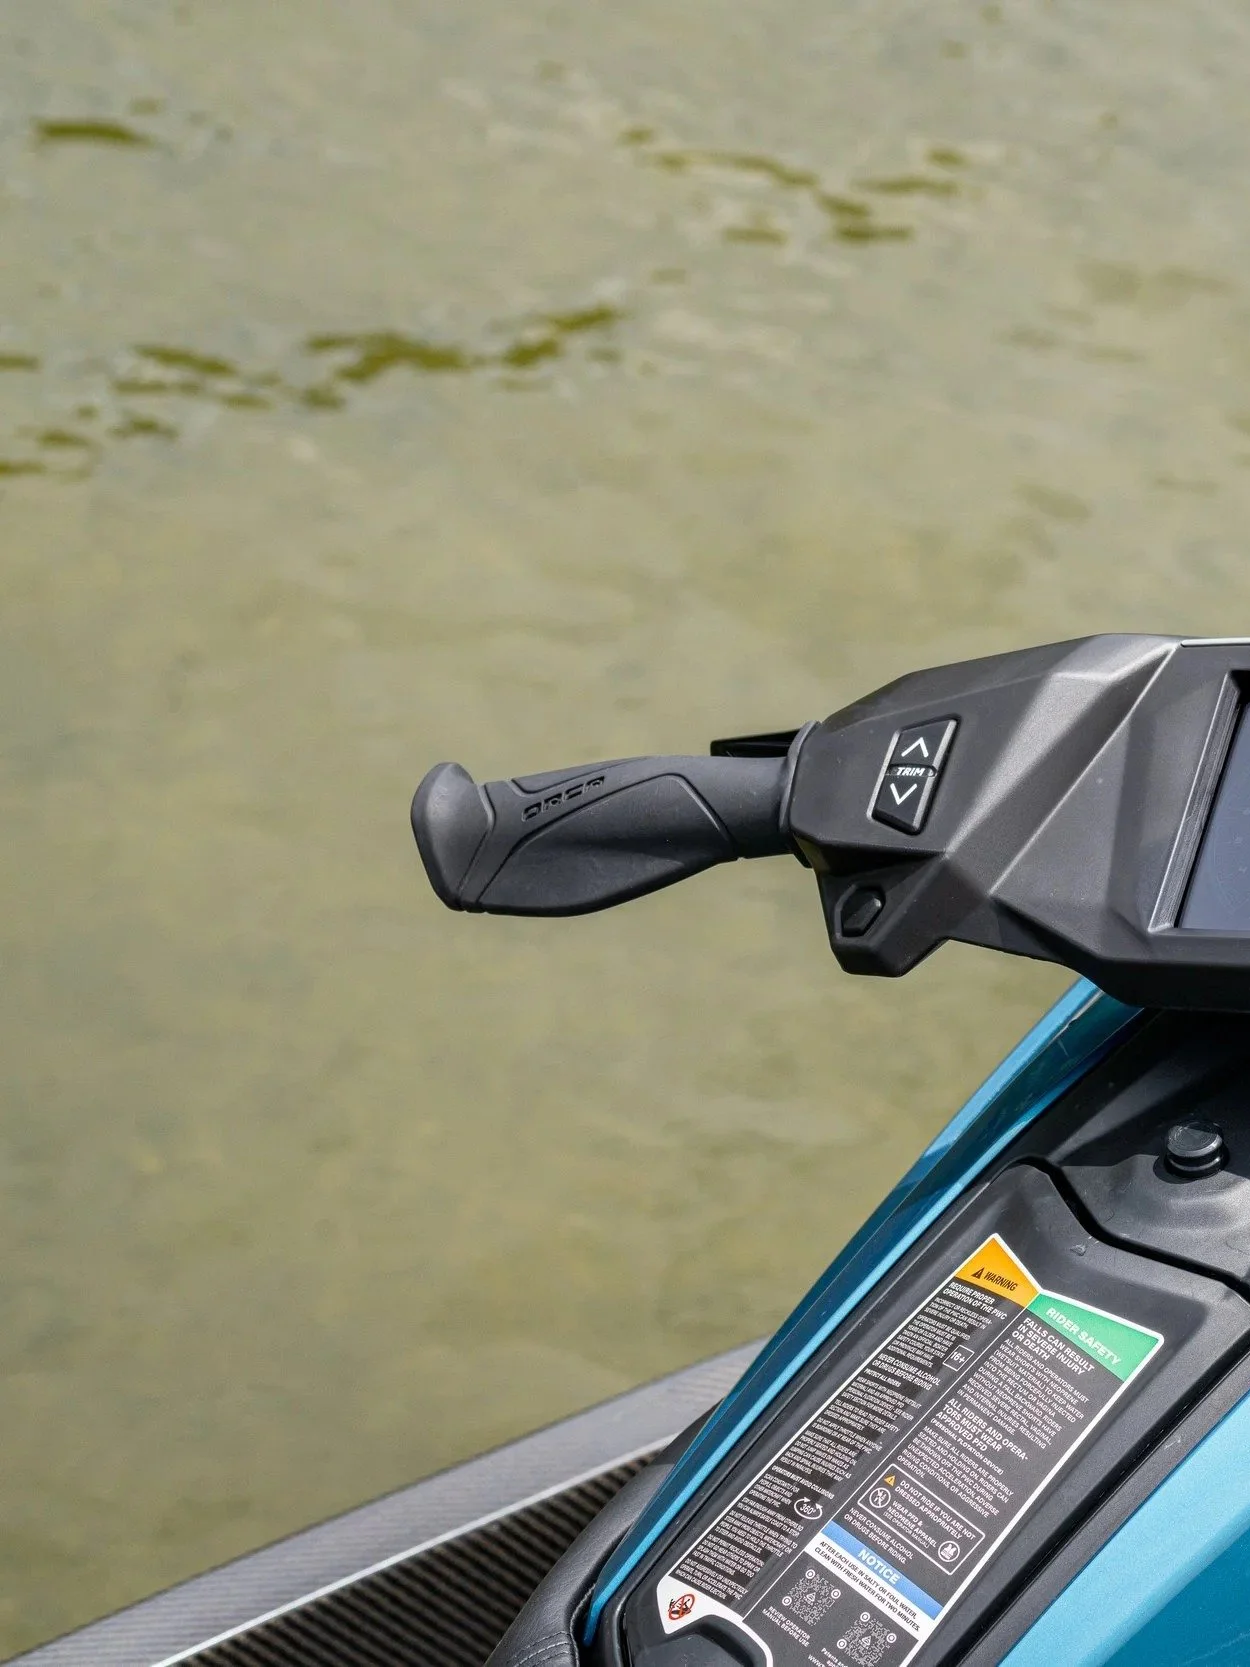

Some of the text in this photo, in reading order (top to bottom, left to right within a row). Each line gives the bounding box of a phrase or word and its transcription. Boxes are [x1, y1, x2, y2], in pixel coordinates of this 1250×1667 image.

[897, 766, 926, 777] TRIM
[941, 1287, 1008, 1320] OPERATION OF THE PWC
[947, 1281, 996, 1304] REQUIRE PROPER
[982, 1271, 1019, 1291] WARNING
[949, 1351, 967, 1363] 16+
[1010, 1329, 1050, 1361] OR DEATH
[1016, 1323, 1085, 1376] IN SEVERE INJURY
[1022, 1316, 1094, 1373] FALLS CAN RESULT
[1045, 1306, 1121, 1366] RIDER SAFETY
[876, 1352, 943, 1385] NEVER CONSUME ALCOHOL
[877, 1362, 897, 1373] DRUGS
[893, 1369, 915, 1381] BEFORE
[911, 1377, 933, 1390] RIDING
[967, 1377, 992, 1398] RECEIVED
[990, 1394, 1011, 1412] SEVERE
[988, 1354, 1076, 1423] FROM BEING FORCEFULLY INJECTED
[993, 1348, 1085, 1420] (WETSUIT MATERIAL) TO KEEP WATER
[999, 1343, 1078, 1405] WEAR SHORTS WITH NEOPRENE
[1004, 1337, 1089, 1404] ALL RIDERS AND OPERATORS MUST
[947, 1397, 963, 1411] ALL
[960, 1407, 988, 1430] RIDERS
[984, 1425, 1003, 1442] AND
[956, 1388, 1016, 1436] IN PERMANENT DAMAGE.
[961, 1382, 1046, 1449] AND INTERNAL INJURIES RESULTING
[972, 1371, 1056, 1437] WITHOUT NEOPRENE SHORTS HAVE
[977, 1365, 999, 1383] DURING
[1001, 1384, 1015, 1396] FALL
[1042, 1414, 1062, 1432] RIDERS
[929, 1417, 1004, 1475] (PERSONAL FLOTATION DEVICE)
[935, 1410, 988, 1452] APPROVED PFD
[941, 1403, 1002, 1452] TORS MUST WEAR
[901, 1448, 990, 1518] RIDING CONDITIONS, OR AGGRESSIVE
[906, 1442, 940, 1469] UNEXPECTED
[974, 1494, 999, 1516] ADVERSE
[917, 1430, 937, 1448] SEATED
[935, 1444, 948, 1456] AND
[946, 1453, 971, 1473] HOLDING
[977, 1477, 998, 1494] RIDERS
[995, 1491, 1009, 1503] CAN
[922, 1425, 1013, 1497] MAKE SURE ALL RIDERS ARE PROPERLY
[848, 1507, 914, 1560] NEVER CONSUME ALCOHOL
[886, 1506, 938, 1547] NEOPRENE APPAREL
[891, 1500, 908, 1515] WEAR
[906, 1511, 919, 1523] PFD
[893, 1485, 962, 1540] DRESSED APPROPRIATELY
[899, 1479, 976, 1541] DO NOT RIDE IF YOU ARE NOT
[843, 1513, 907, 1564] OR DRUGS BEFORE RIDING.
[813, 1546, 921, 1632] CLEAN WITH FRESH WATER FOR TWO MINUTES.
[819, 1540, 918, 1619] AFTER EACH USE IN SALTY OR FOUL WATER,
[857, 1548, 901, 1585] NOTICE
[761, 1607, 809, 1647] MANUAL BEFORE USE
[767, 1605, 810, 1641] REVIEW OPERATOR
